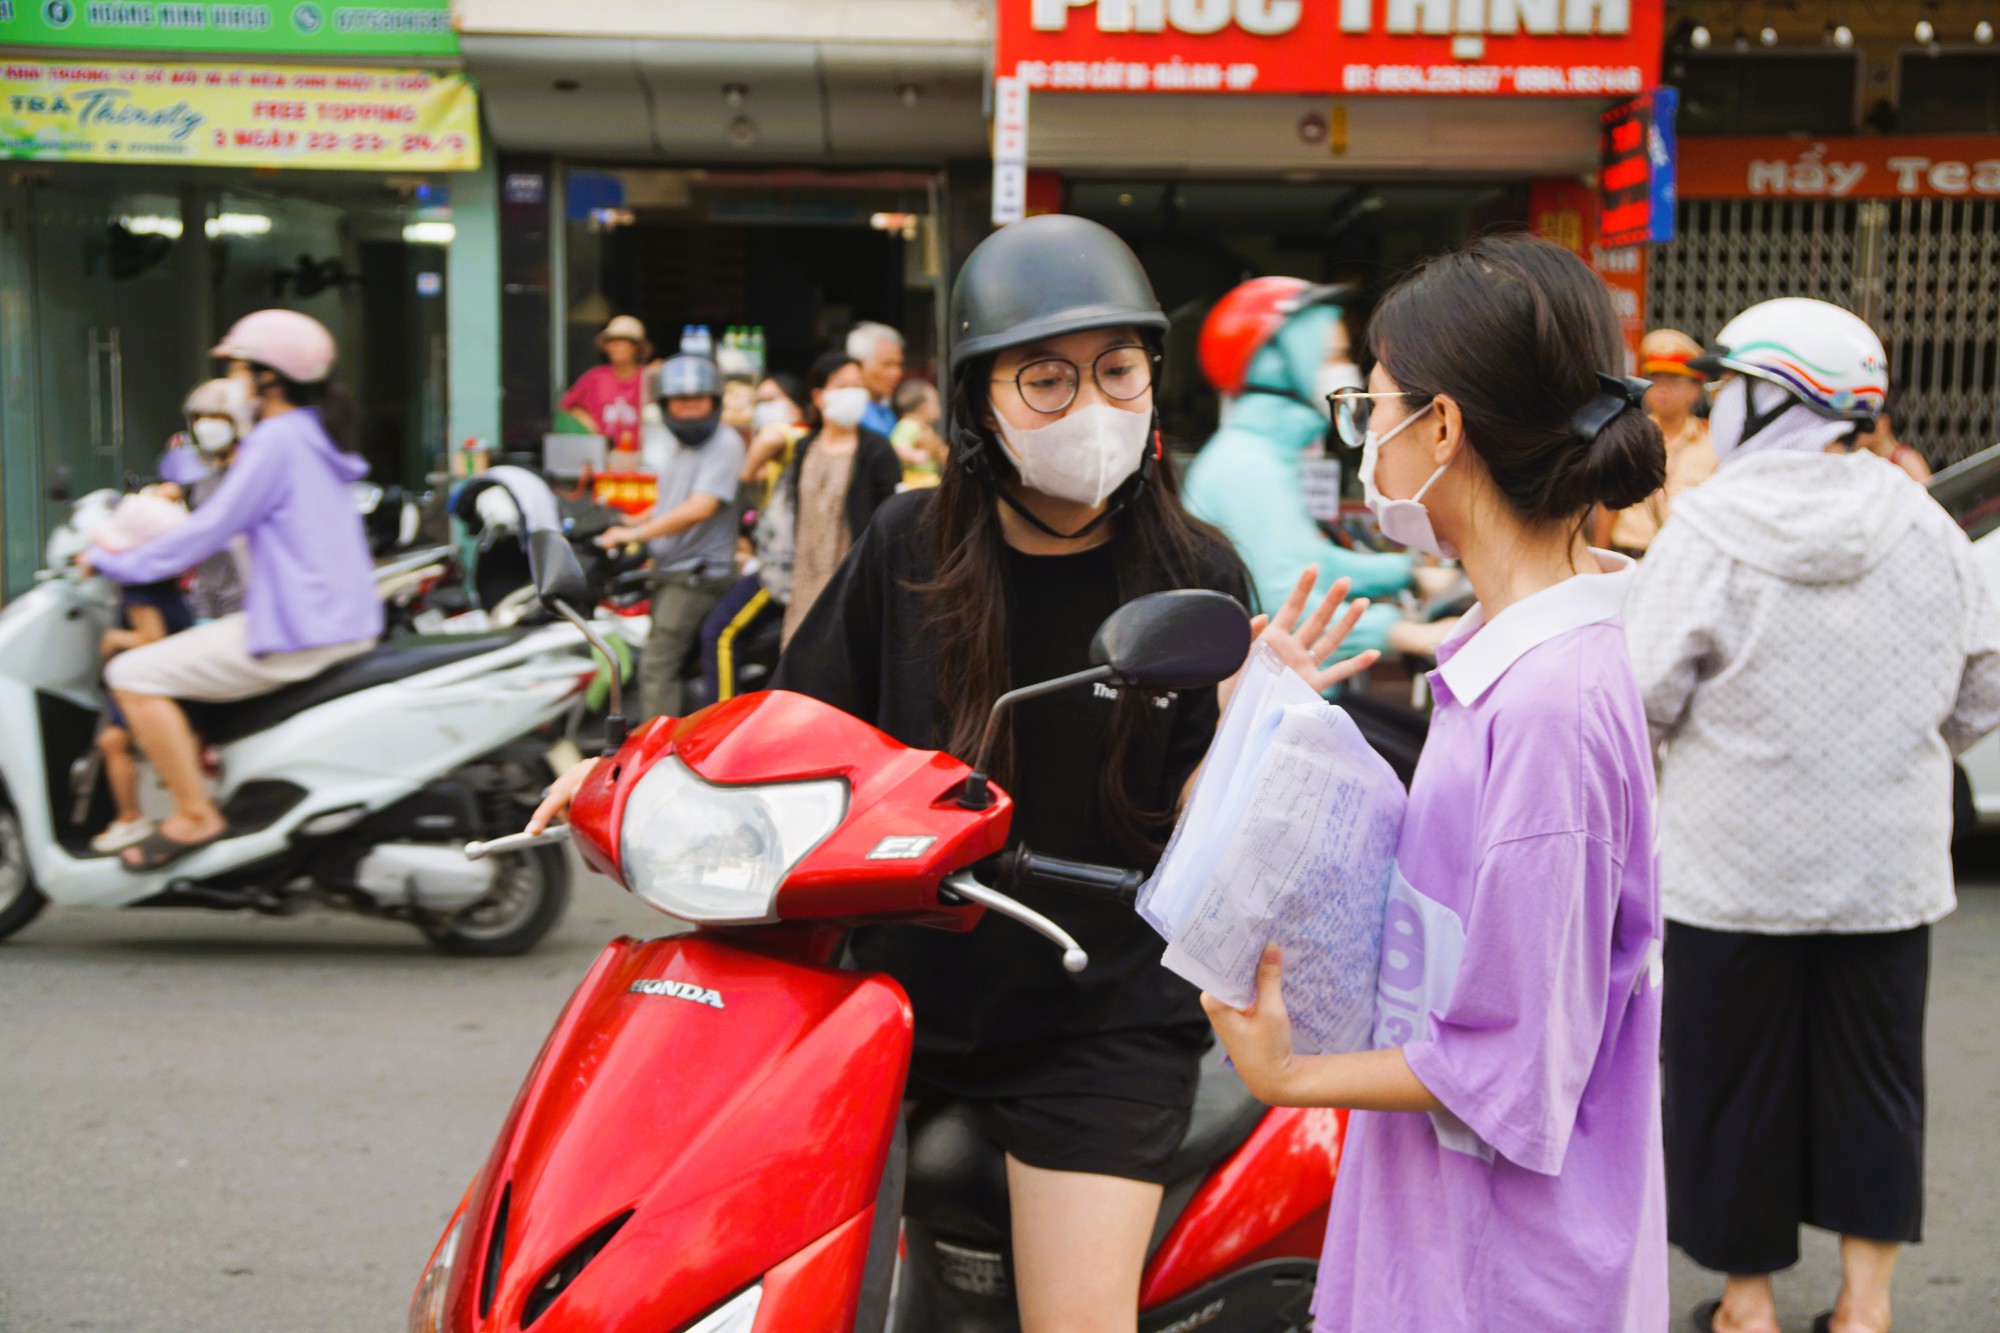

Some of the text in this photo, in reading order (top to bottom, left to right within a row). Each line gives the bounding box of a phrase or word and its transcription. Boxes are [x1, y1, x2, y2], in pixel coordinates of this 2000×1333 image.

[252, 102, 417, 123] FREE TOPPING
[1887, 157, 2000, 195] Tea
[1094, 683, 1118, 699] The
[628, 980, 724, 1009] HONDA
